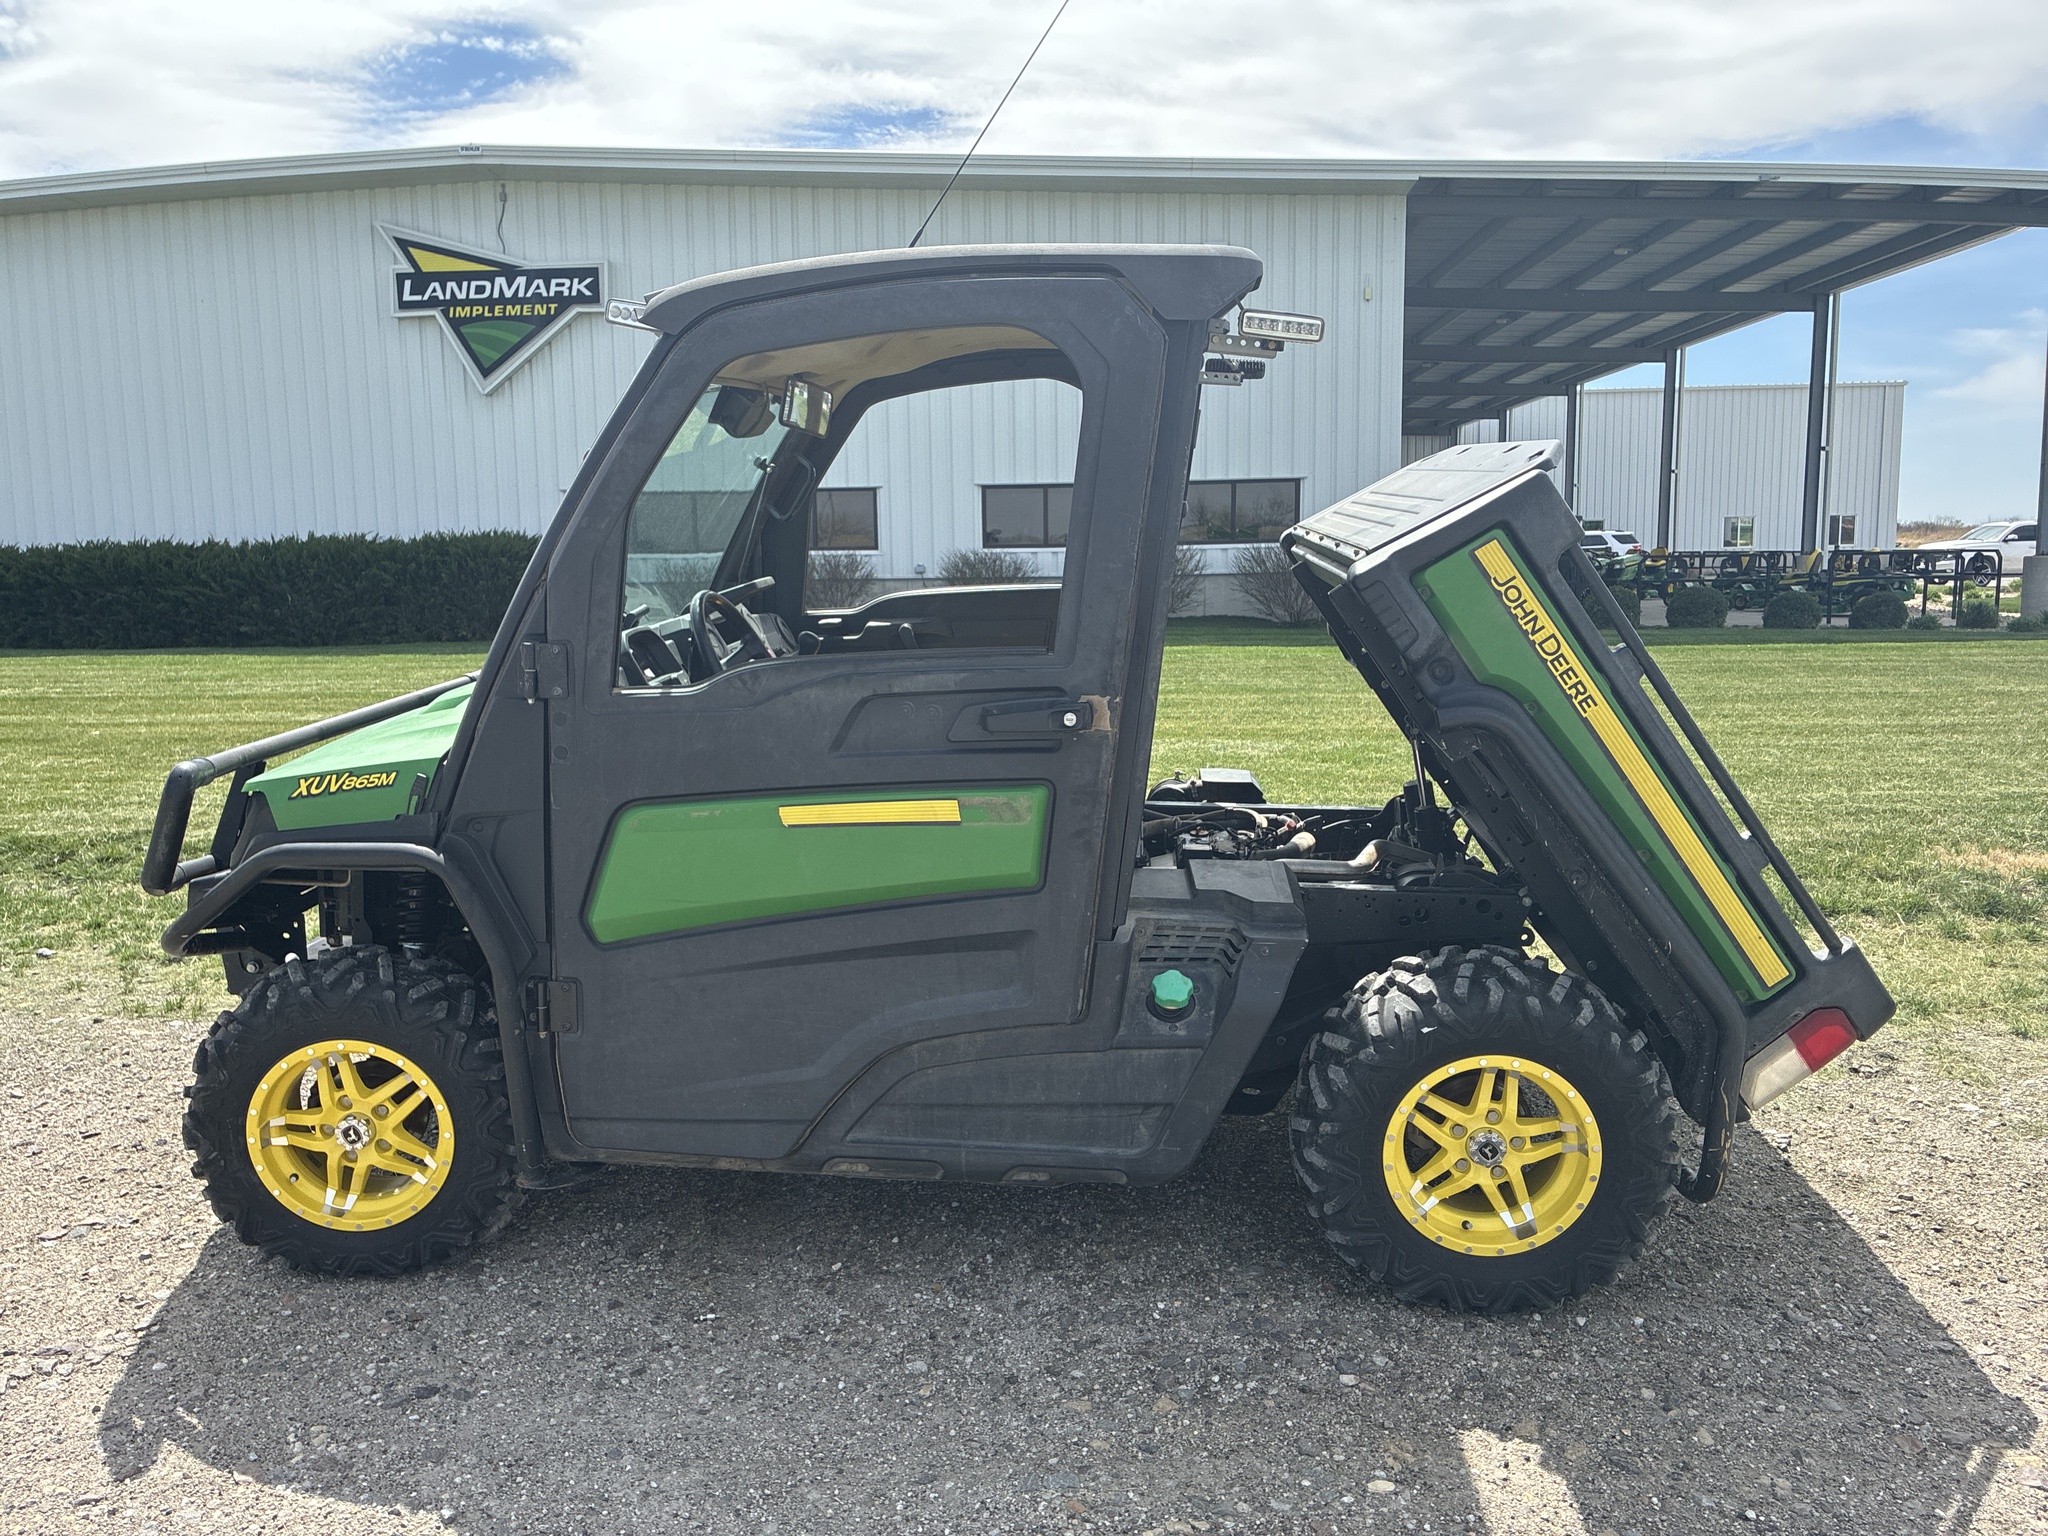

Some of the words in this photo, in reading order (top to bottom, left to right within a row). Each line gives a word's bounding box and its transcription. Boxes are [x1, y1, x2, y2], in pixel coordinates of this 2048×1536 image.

[402, 276, 594, 301] LANDMARK
[449, 304, 558, 318] IMPLEMENT
[1492, 575, 1545, 638] JOHN
[1537, 633, 1598, 714] DEERE
[290, 771, 397, 798] XUV865M
